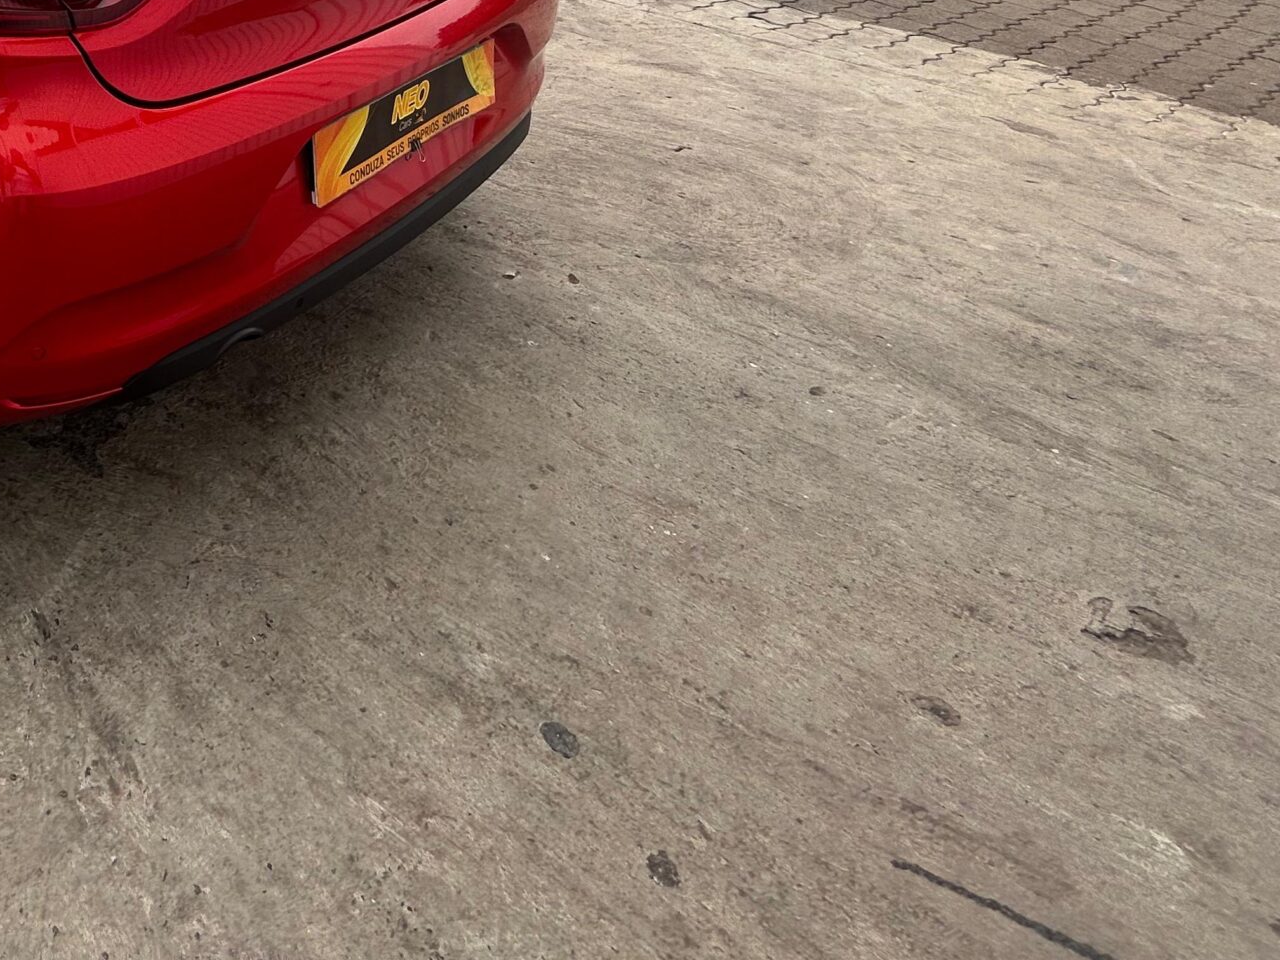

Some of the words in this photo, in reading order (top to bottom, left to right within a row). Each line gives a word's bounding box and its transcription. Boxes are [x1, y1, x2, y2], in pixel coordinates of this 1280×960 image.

[391, 79, 430, 125] NEO
[349, 154, 385, 185] CONDUZA
[386, 141, 405, 161] SEUS
[442, 103, 470, 127] SONHOS
